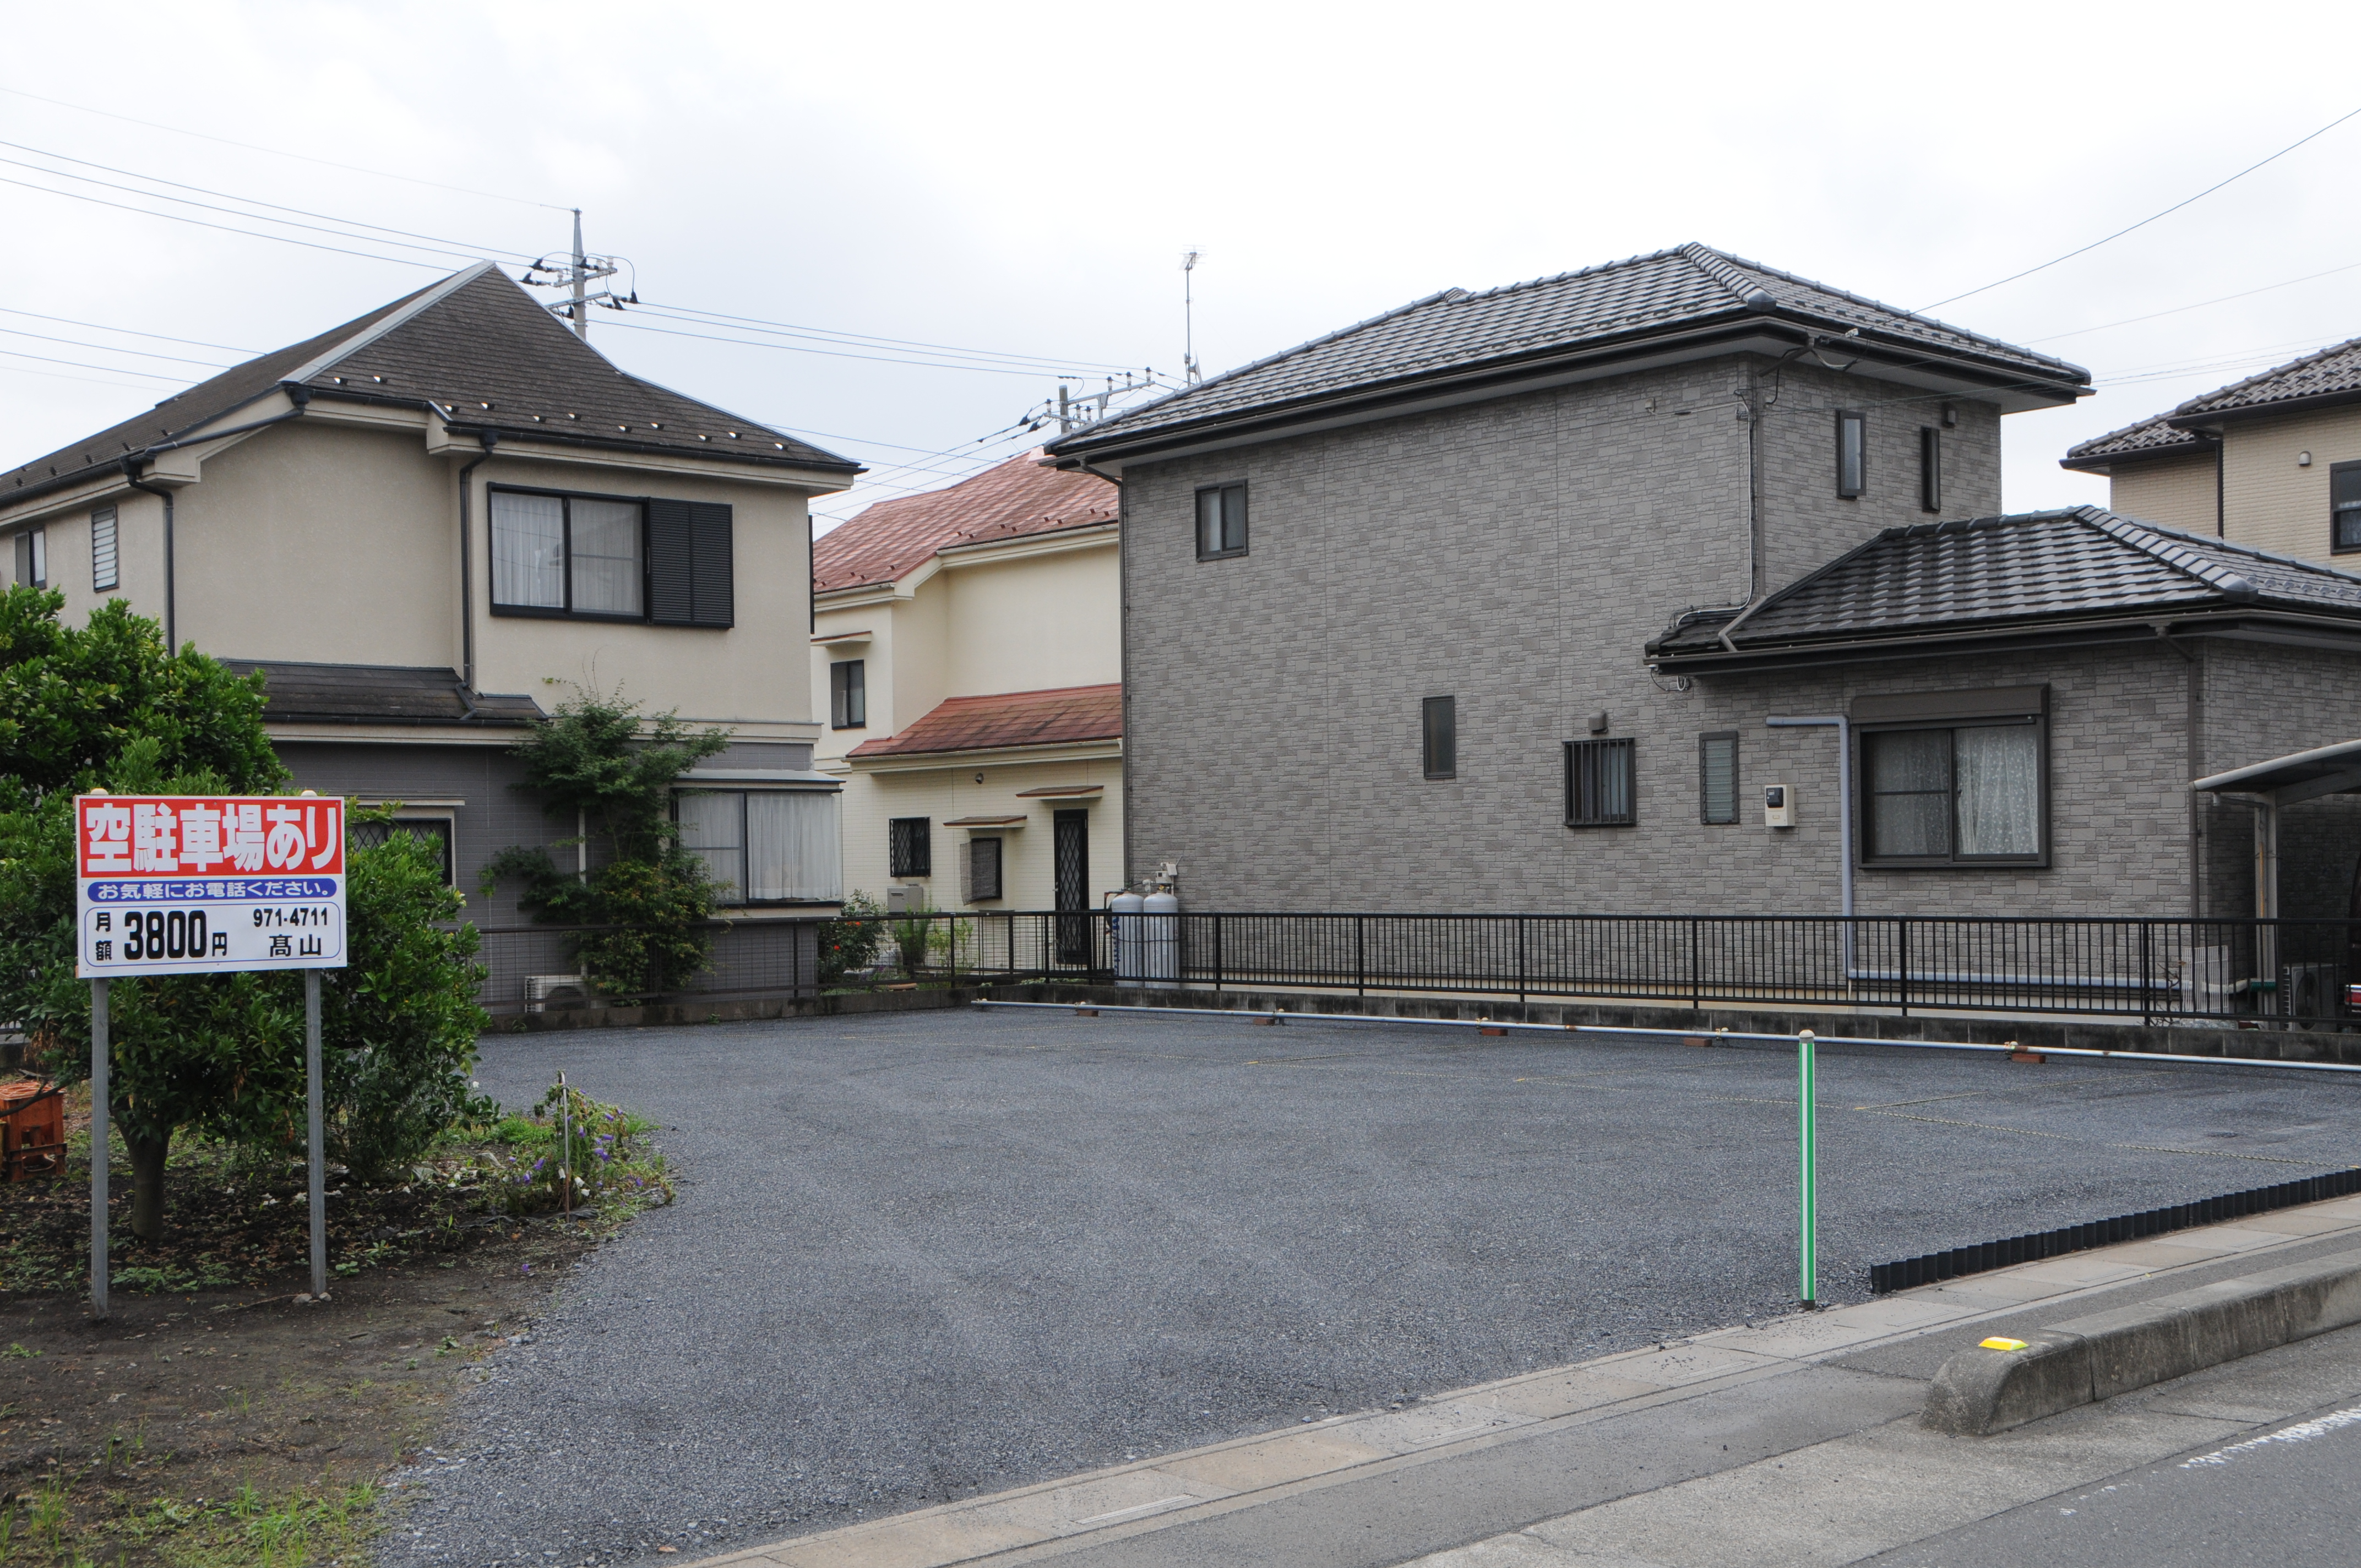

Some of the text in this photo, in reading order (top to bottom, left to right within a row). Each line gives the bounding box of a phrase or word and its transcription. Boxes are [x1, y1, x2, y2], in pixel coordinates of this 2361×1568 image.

[86, 802, 336, 872] 空駐車場あり
[98, 882, 330, 899] お気軽にお電話ください。
[253, 907, 327, 927] 971-4711
